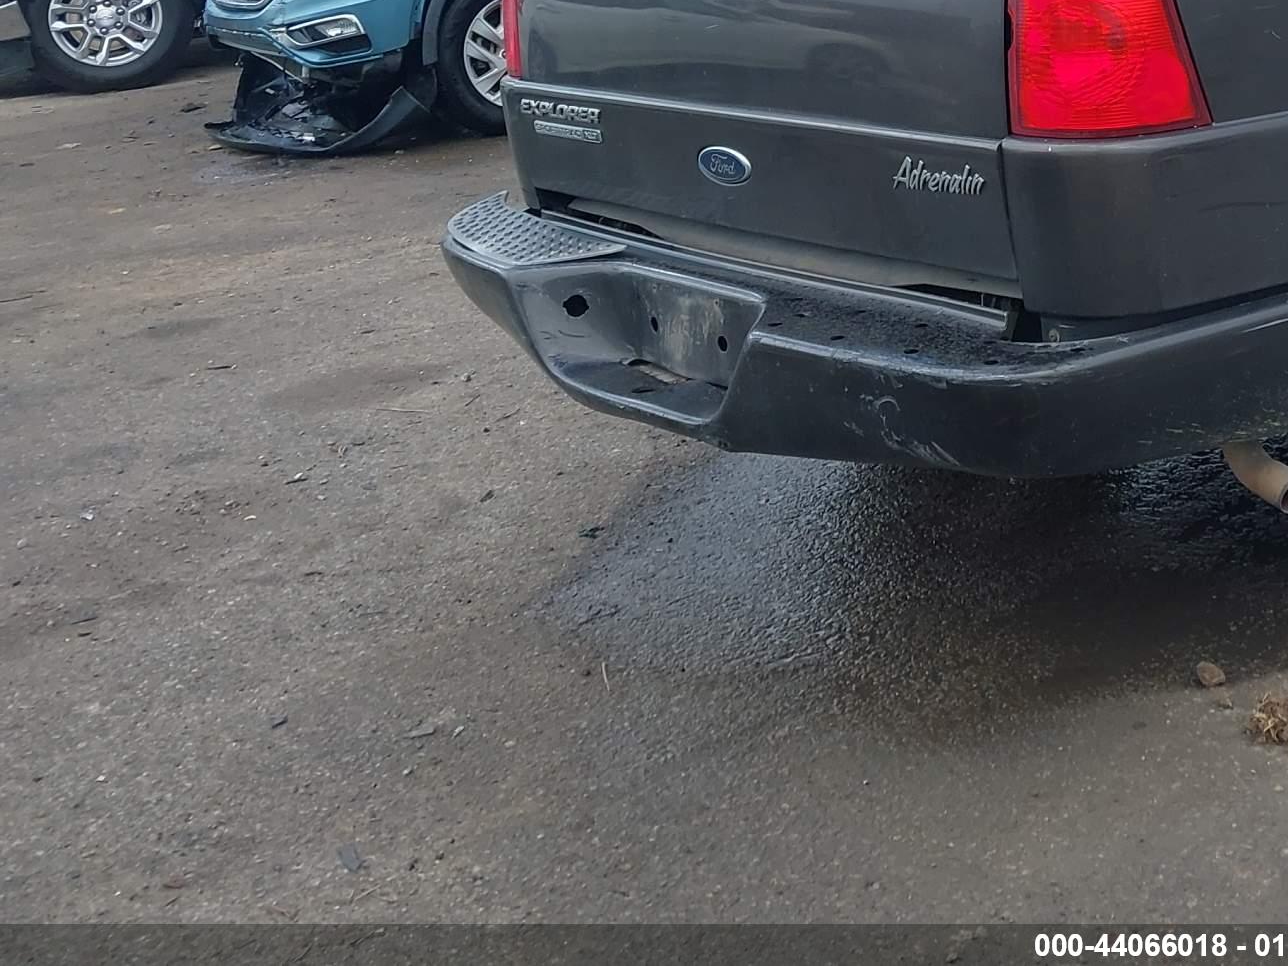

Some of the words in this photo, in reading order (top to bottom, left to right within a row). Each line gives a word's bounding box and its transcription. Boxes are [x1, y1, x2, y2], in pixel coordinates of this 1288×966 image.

[520, 98, 601, 124] EXPLORER
[709, 153, 736, 176] Ford
[892, 155, 985, 195] Adrenalin
